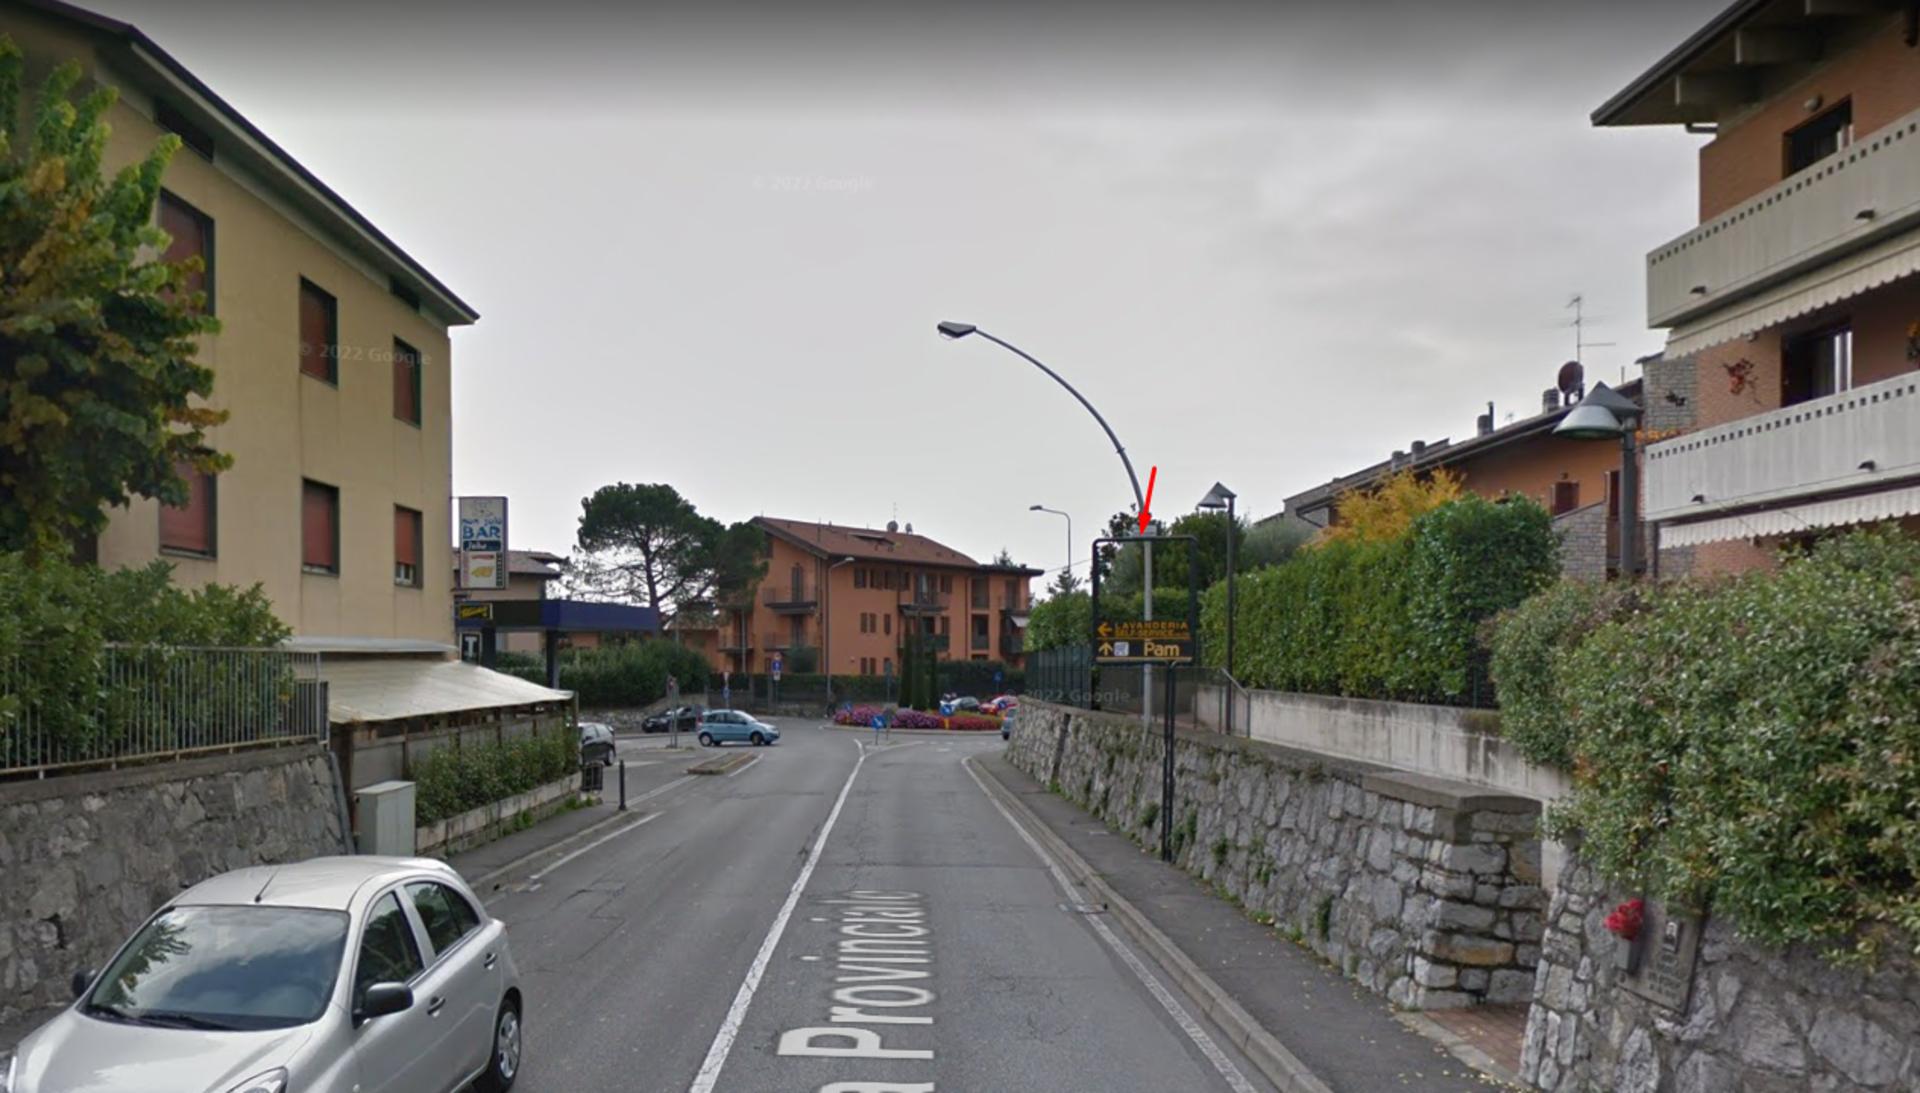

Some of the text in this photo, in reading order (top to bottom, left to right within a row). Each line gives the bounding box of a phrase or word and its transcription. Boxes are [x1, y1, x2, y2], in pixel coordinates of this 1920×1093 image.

[462, 526, 501, 540] BAR
[1115, 621, 1188, 630] LAVANDERIA
[1143, 641, 1181, 657] Pam
[777, 889, 936, 1060] Provinciale
